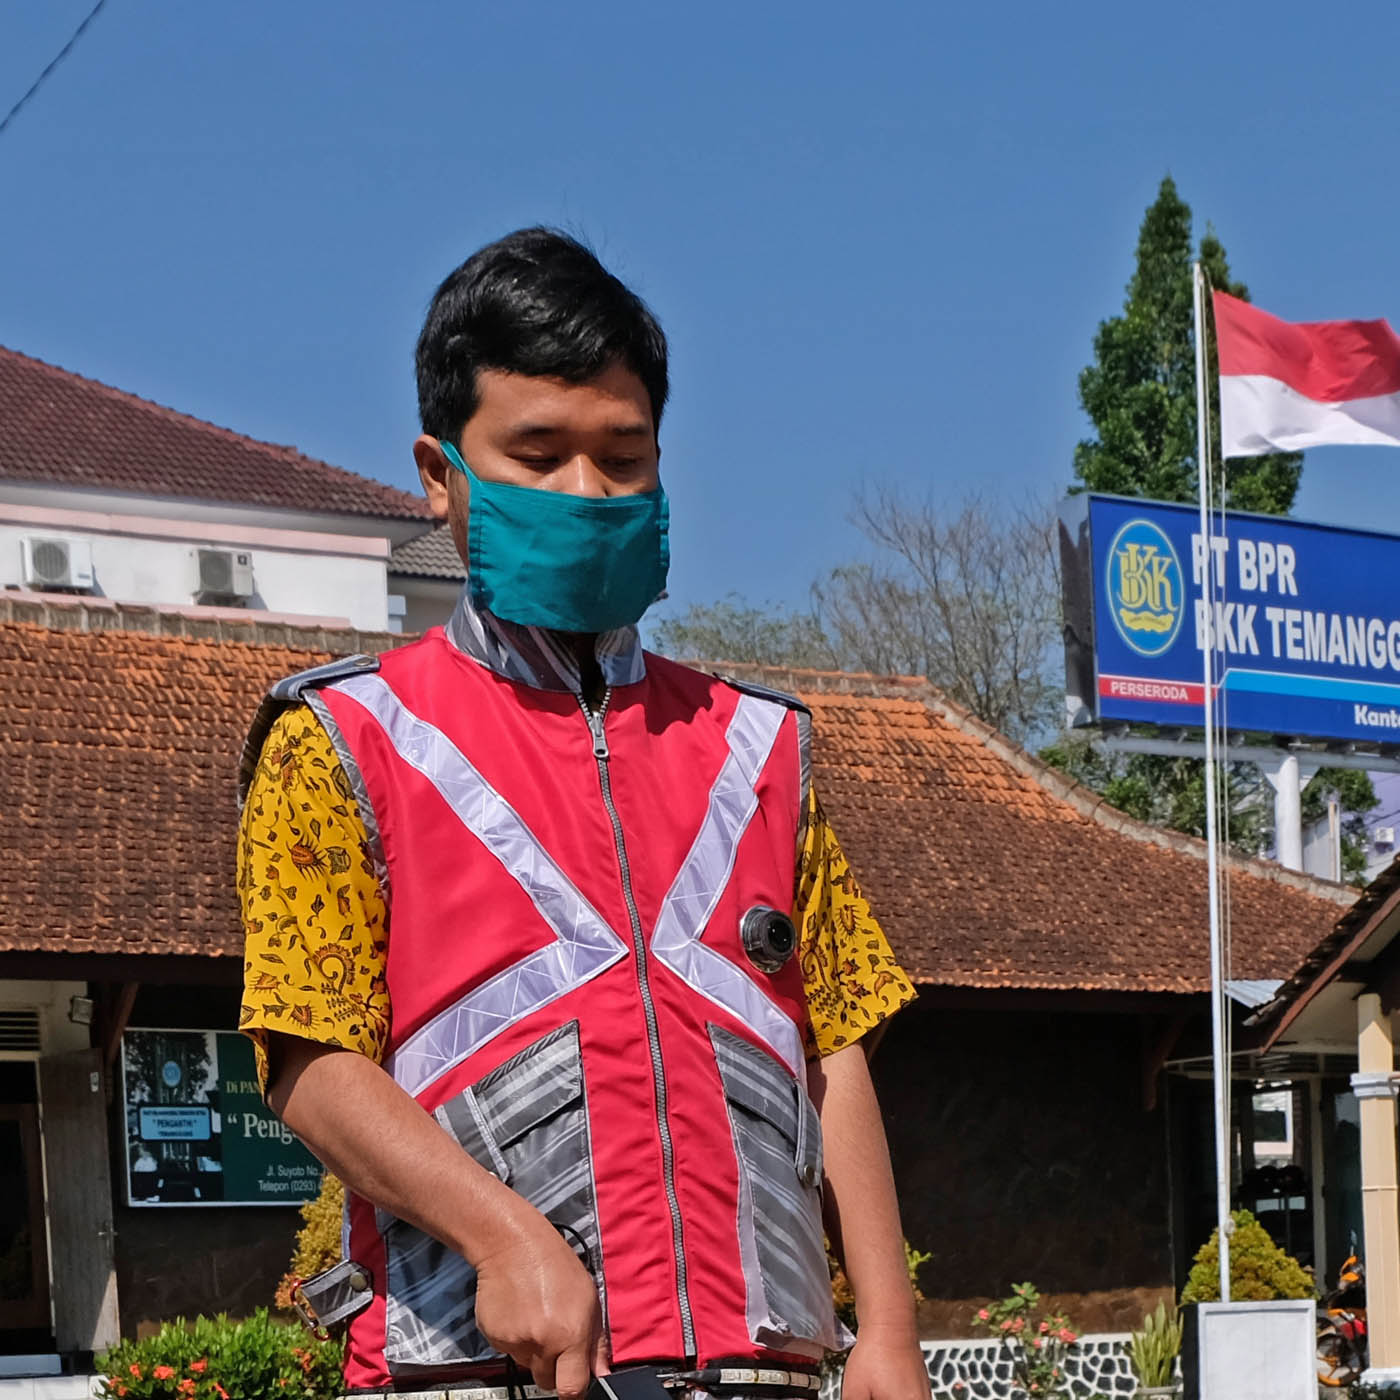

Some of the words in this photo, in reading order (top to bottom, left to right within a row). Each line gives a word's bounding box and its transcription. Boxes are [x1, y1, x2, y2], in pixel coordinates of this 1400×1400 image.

[1192, 533, 1229, 588] PT
[1238, 538, 1299, 597] BPR
[1194, 599, 1261, 656] BKK
[1110, 680, 1189, 701] PERSERODA
